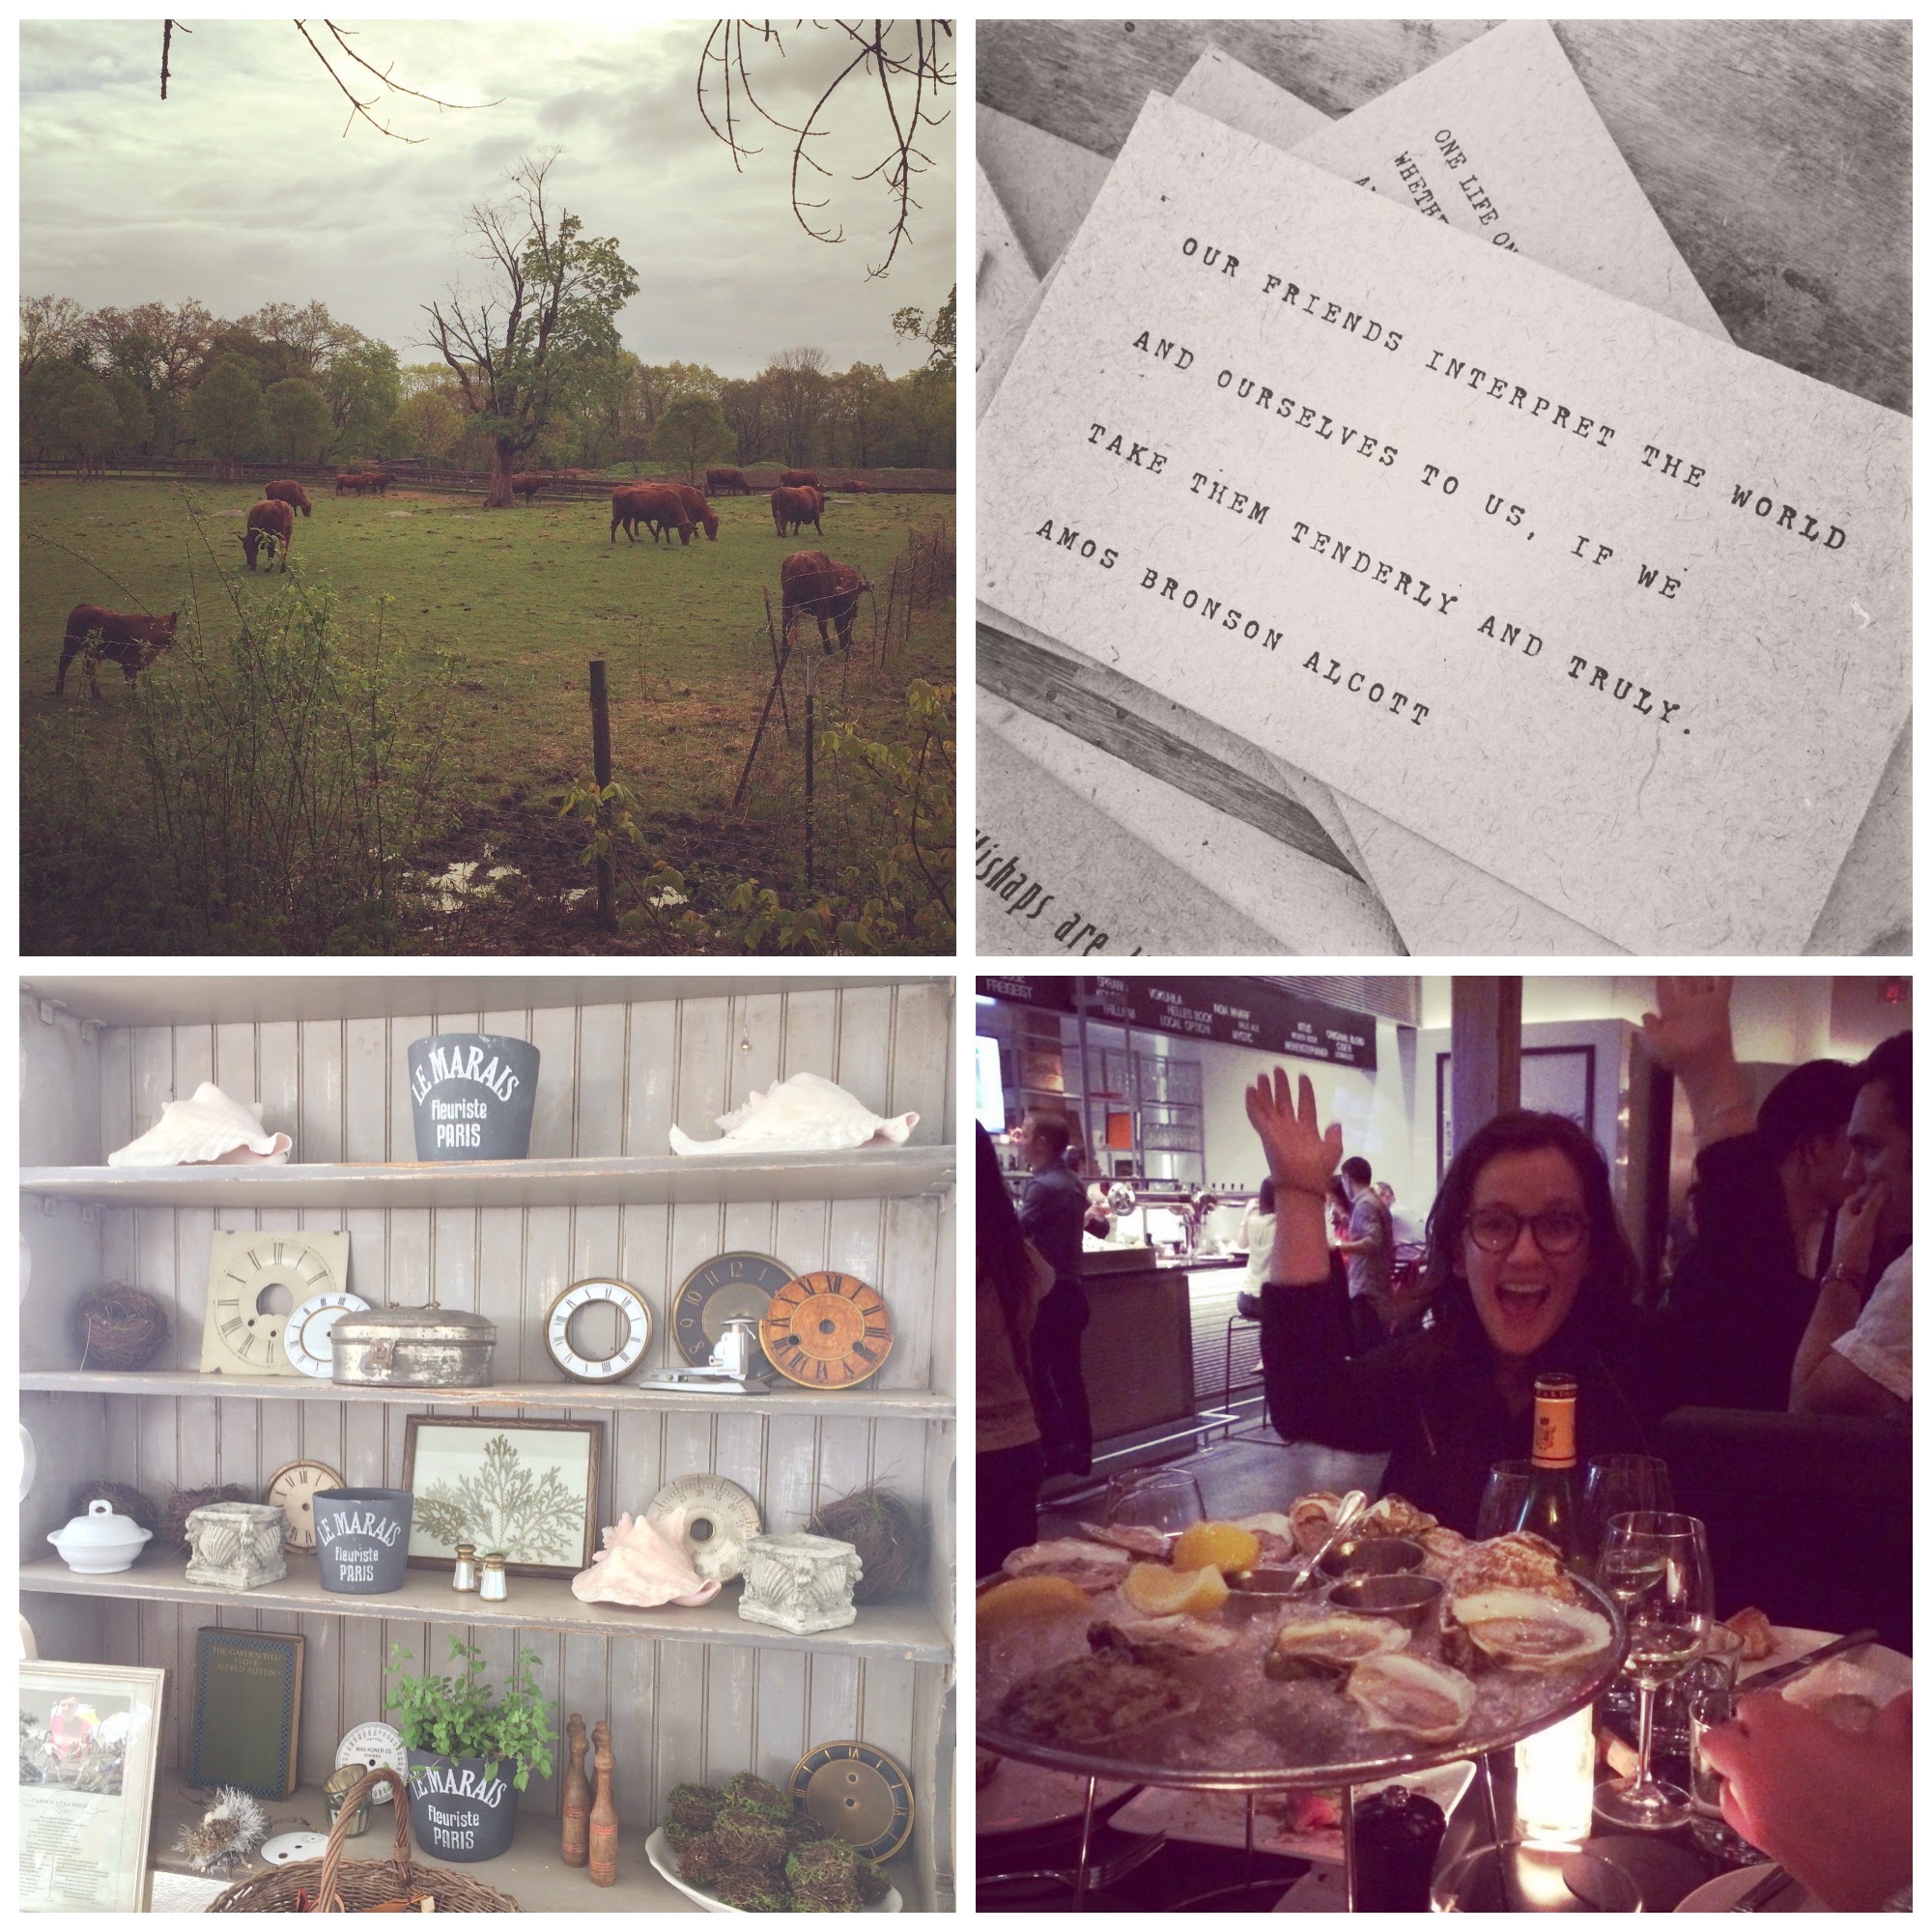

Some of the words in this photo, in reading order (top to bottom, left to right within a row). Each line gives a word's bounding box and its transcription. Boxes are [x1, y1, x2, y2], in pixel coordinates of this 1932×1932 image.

[1435, 129, 1466, 169] ONE
[1459, 174, 1498, 225] LIFE
[1182, 237, 1239, 277] OUR
[1263, 274, 1403, 352] FRIENDS
[1425, 349, 1615, 447] INTERPRET
[1642, 444, 1705, 488] THE
[1730, 485, 1846, 550] WORLD
[1133, 330, 1194, 370] AND
[1217, 370, 1398, 466] OURSELVES
[1421, 464, 1459, 495] TO
[1485, 494, 1535, 541] US,
[1572, 535, 1613, 565] IF
[1637, 564, 1681, 599] WE
[1088, 423, 1168, 474] TAKE
[1190, 472, 1270, 525] THEM
[1292, 522, 1459, 615] TENDERLY
[1477, 615, 1543, 657] AND
[1568, 656, 1690, 734] TRULY.
[1037, 520, 1119, 569] AMOS
[1140, 568, 1283, 651] BRONSON
[1303, 651, 1430, 726] ALCOTT
[1054, 913, 1109, 956] are
[1159, 1014, 1182, 1029] LOCAL
[1184, 1020, 1211, 1035] OPTION
[412, 1065, 432, 1106] LE
[429, 1045, 520, 1102] MARAIS
[437, 1123, 481, 1148] PARIS
[730, 1262, 743, 1277] 12
[685, 1291, 702, 1306] 10
[317, 1518, 335, 1547] LE
[333, 1511, 402, 1548] MARAIS
[339, 1564, 374, 1581] PARIS
[213, 1646, 226, 1655] THE
[229, 1648, 261, 1660] GARDEN
[263, 1653, 282, 1662] THAT
[216, 1662, 245, 1673] ALFRED
[247, 1666, 276, 1677] AUSTIN
[425, 1766, 507, 1808] MARAIS
[433, 1827, 474, 1850] PARIS
